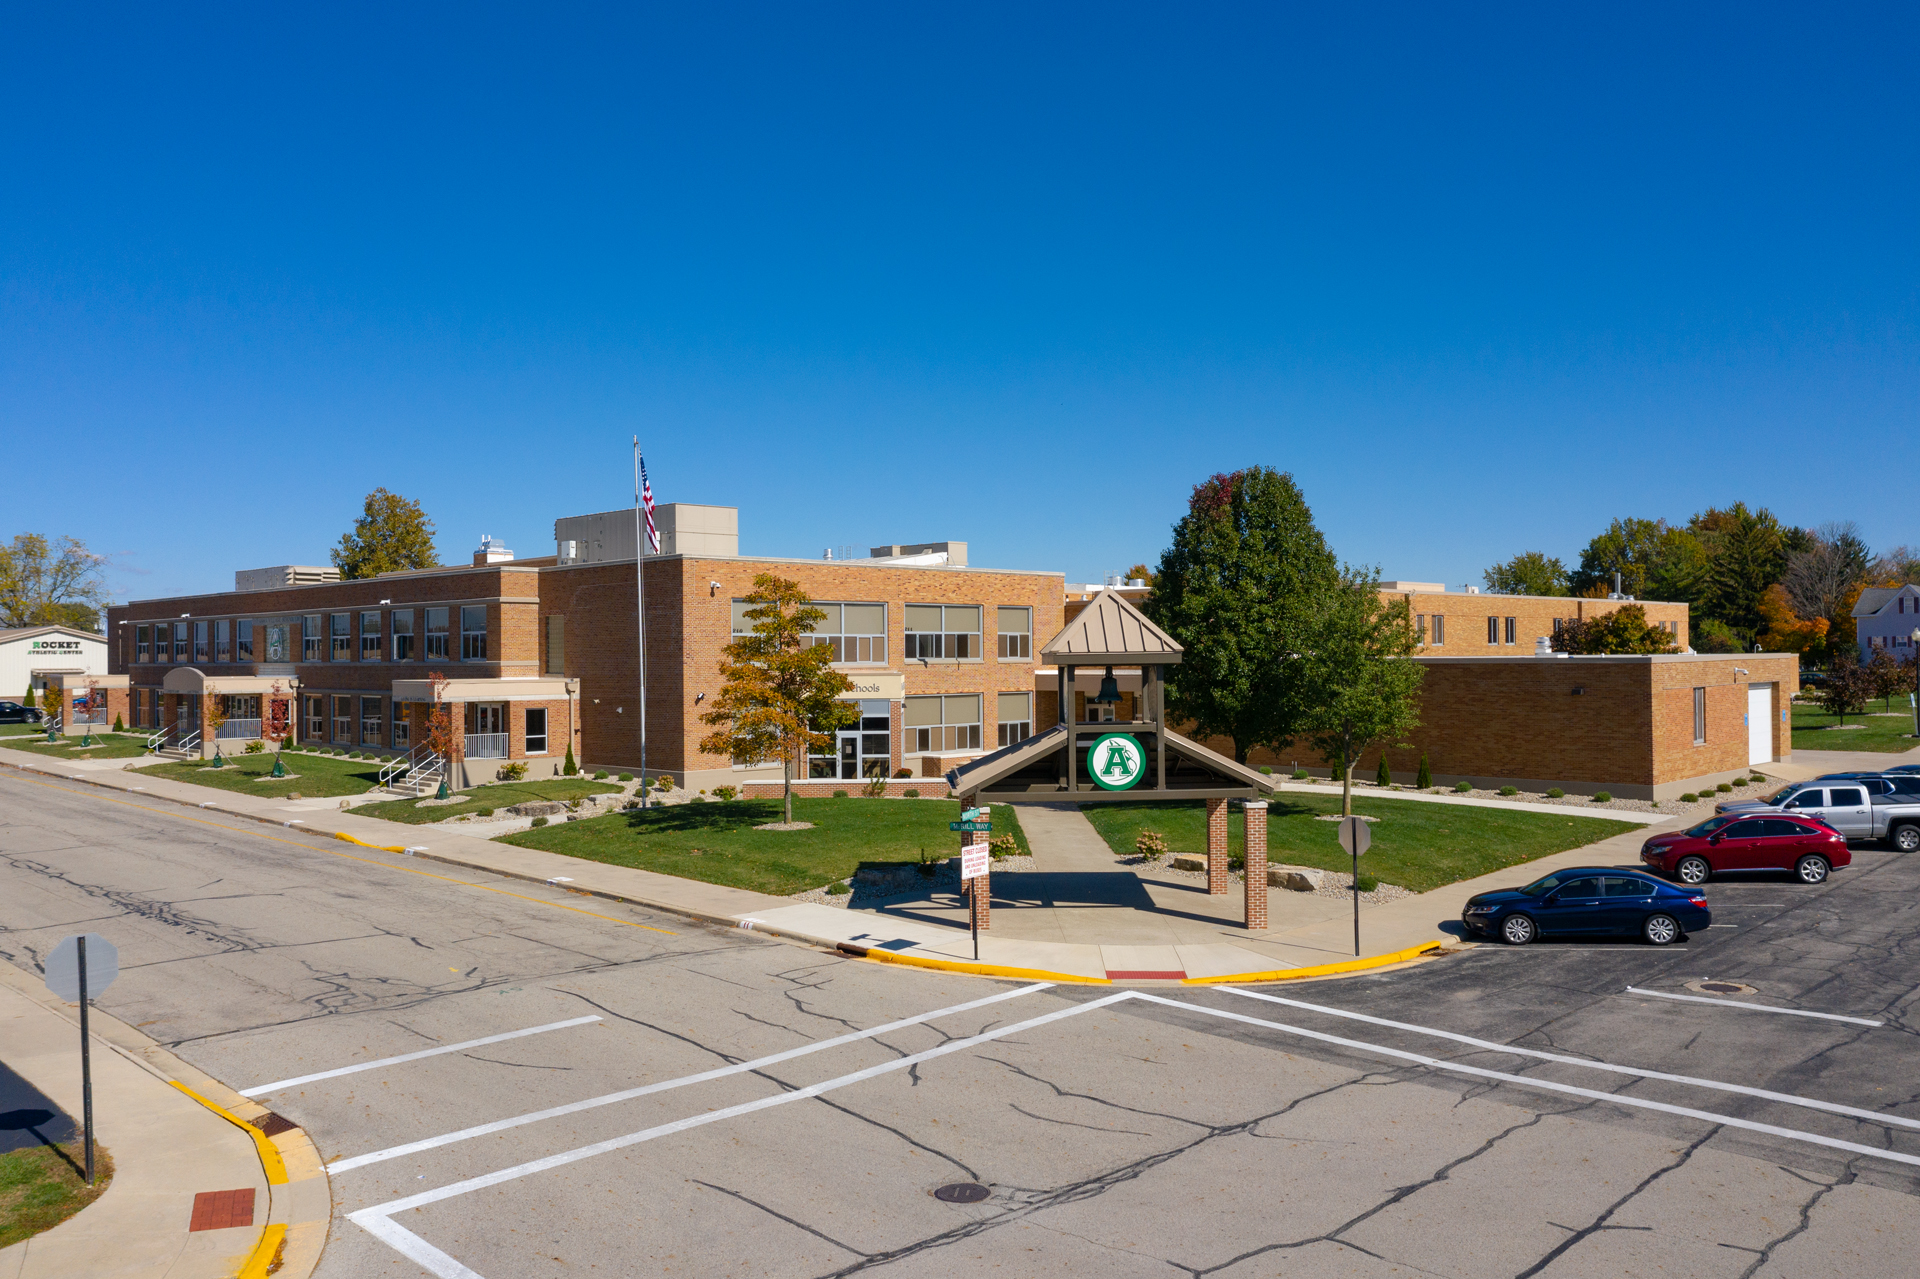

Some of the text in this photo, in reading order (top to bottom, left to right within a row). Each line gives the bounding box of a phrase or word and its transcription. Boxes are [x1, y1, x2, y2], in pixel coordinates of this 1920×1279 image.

[845, 683, 880, 692] hools
[1100, 745, 1133, 777] A
[976, 846, 987, 854] CLOSED
